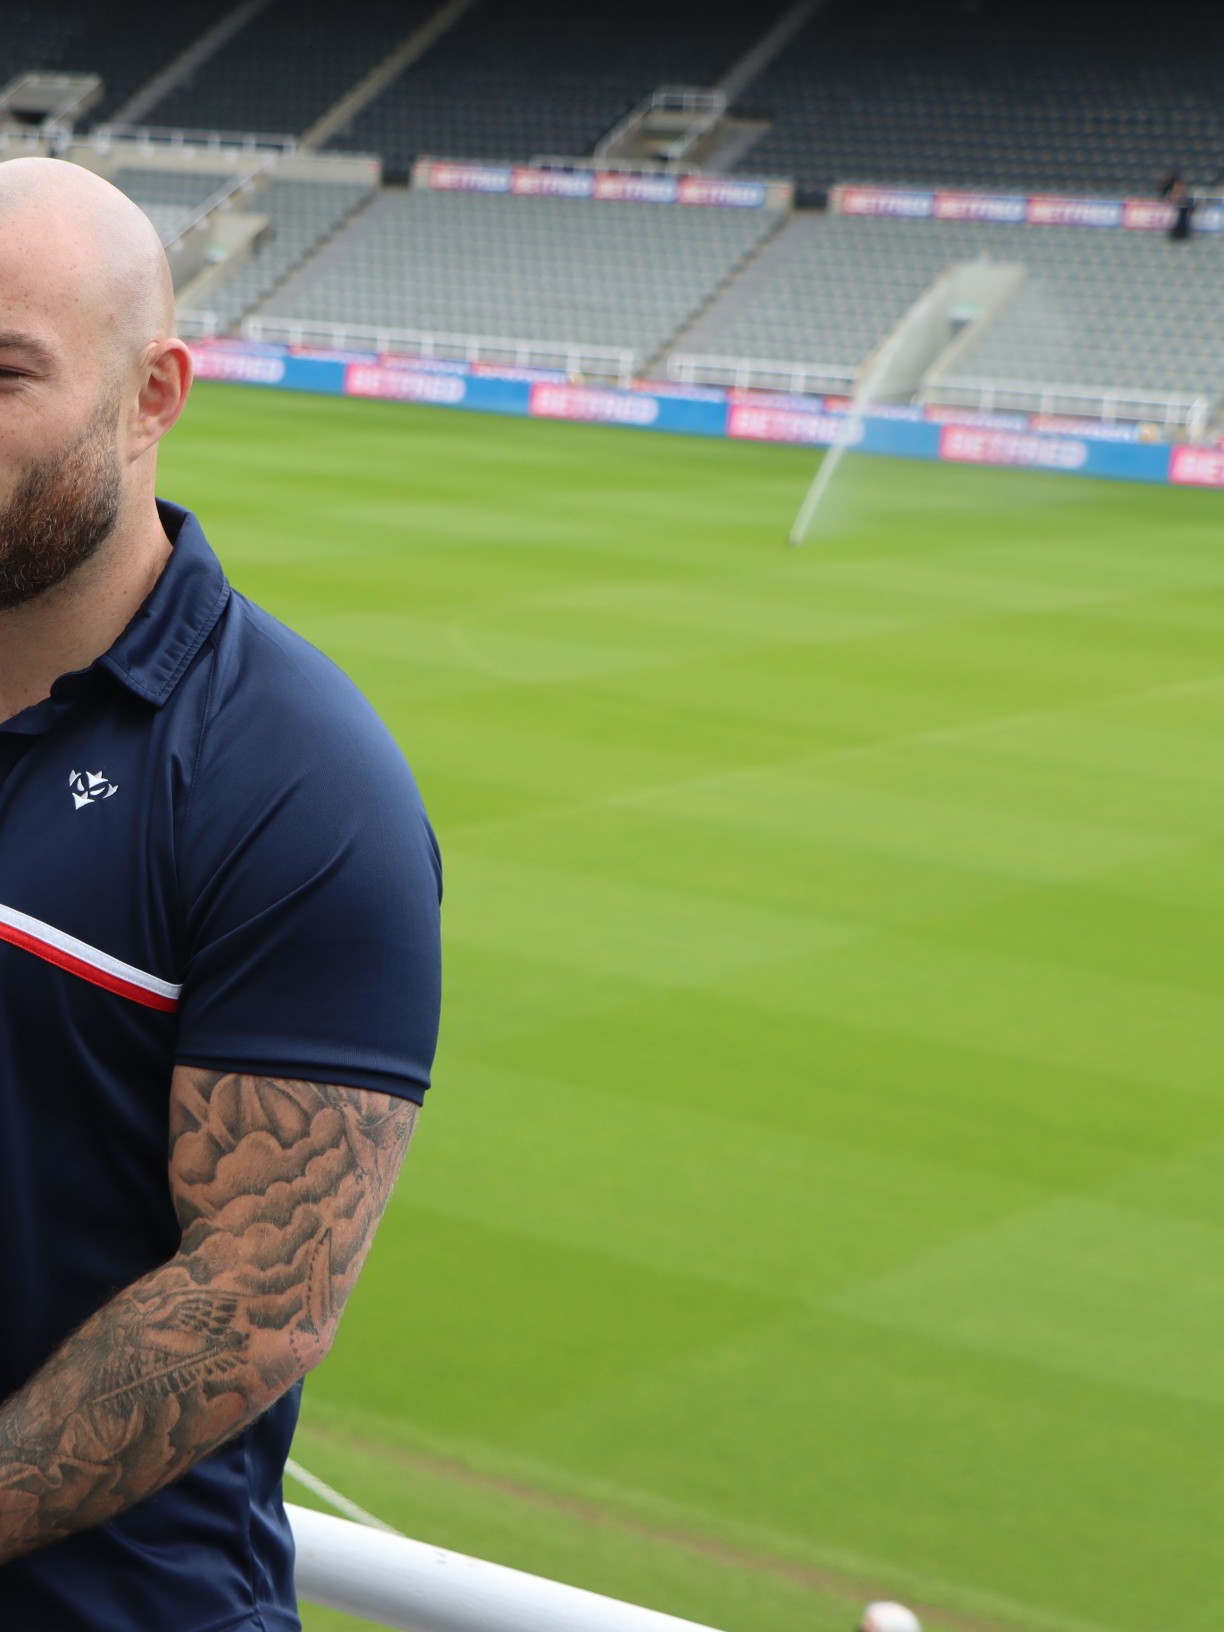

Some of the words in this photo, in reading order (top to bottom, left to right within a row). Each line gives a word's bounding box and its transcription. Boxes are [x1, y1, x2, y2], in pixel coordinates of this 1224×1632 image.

[356, 368, 461, 402] BETFRED
[539, 390, 655, 424] BETFRED
[951, 430, 1084, 468] BETFRED
